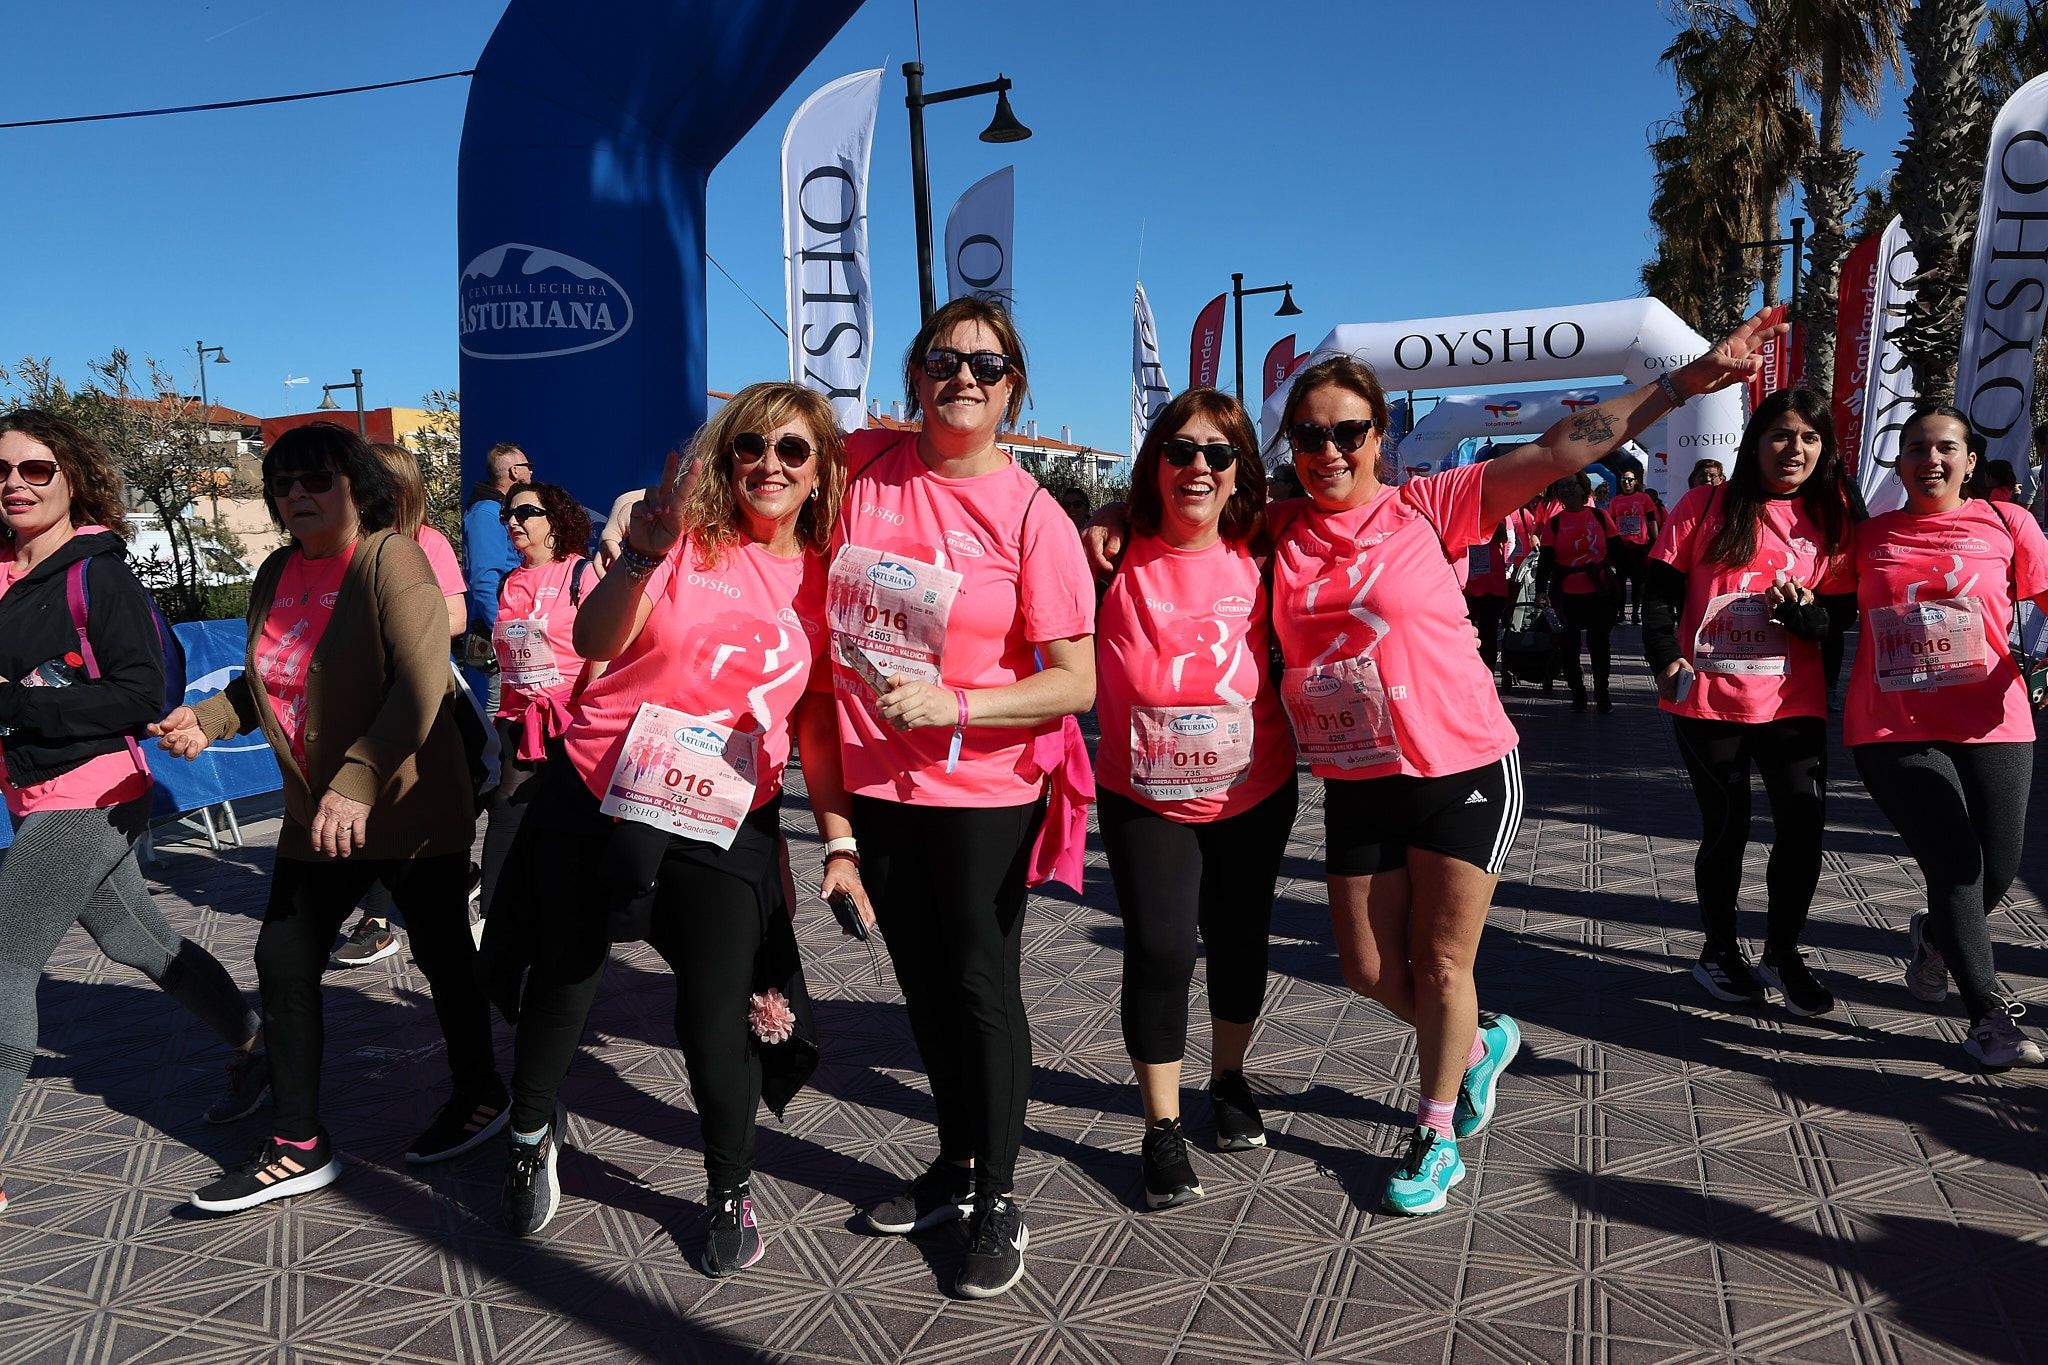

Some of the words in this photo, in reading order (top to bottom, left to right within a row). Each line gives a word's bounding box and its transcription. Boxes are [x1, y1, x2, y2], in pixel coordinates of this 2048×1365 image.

[466, 284, 521, 299] CENTRAL
[529, 284, 607, 296] LECHERA
[799, 165, 863, 403] YSHO
[1969, 129, 2048, 439] OYSHO
[459, 294, 616, 336] ASTURIANA
[1851, 263, 1878, 383] Santander
[1393, 321, 1586, 371] OYSHO
[1200, 329, 1215, 386] ander
[1763, 340, 1776, 398] ntander
[1485, 420, 1522, 428] TotalEnergies
[1678, 432, 1737, 448] OYSHO
[1266, 456, 1290, 468] OYS
[859, 500, 906, 527] OYSHO
[840, 563, 861, 576] SUMA
[869, 568, 912, 587] ASTURIANA
[687, 573, 742, 600] OYSHO
[863, 604, 908, 632] 016
[1905, 612, 1944, 623] ASTURIANA
[868, 630, 891, 643] 4503
[1729, 629, 1766, 643] 016
[510, 648, 532, 659] 016
[866, 641, 874, 649] LA
[874, 644, 895, 654] MUJER
[900, 649, 927, 661] VALENCIA
[1910, 638, 1952, 656] 016
[888, 661, 927, 676] Santander
[1920, 656, 1940, 665] 5698
[1304, 681, 1338, 694] ASTURIANA
[1172, 721, 1215, 731] ASTURIANA
[1317, 710, 1356, 732] 016
[643, 724, 669, 739] SUMA
[678, 731, 726, 754] ASTURIANA
[1173, 751, 1218, 767] 016
[664, 768, 715, 798] 016
[1213, 772, 1237, 782] VALENCIA
[1145, 788, 1182, 796] OYSHO
[1204, 781, 1232, 793] Santand
[670, 793, 689, 805] 734
[618, 803, 660, 819] OYSHO
[625, 791, 653, 805] CARRERA
[654, 798, 664, 806] DE
[696, 810, 724, 824] VALENCIA
[682, 822, 720, 837] Santander
